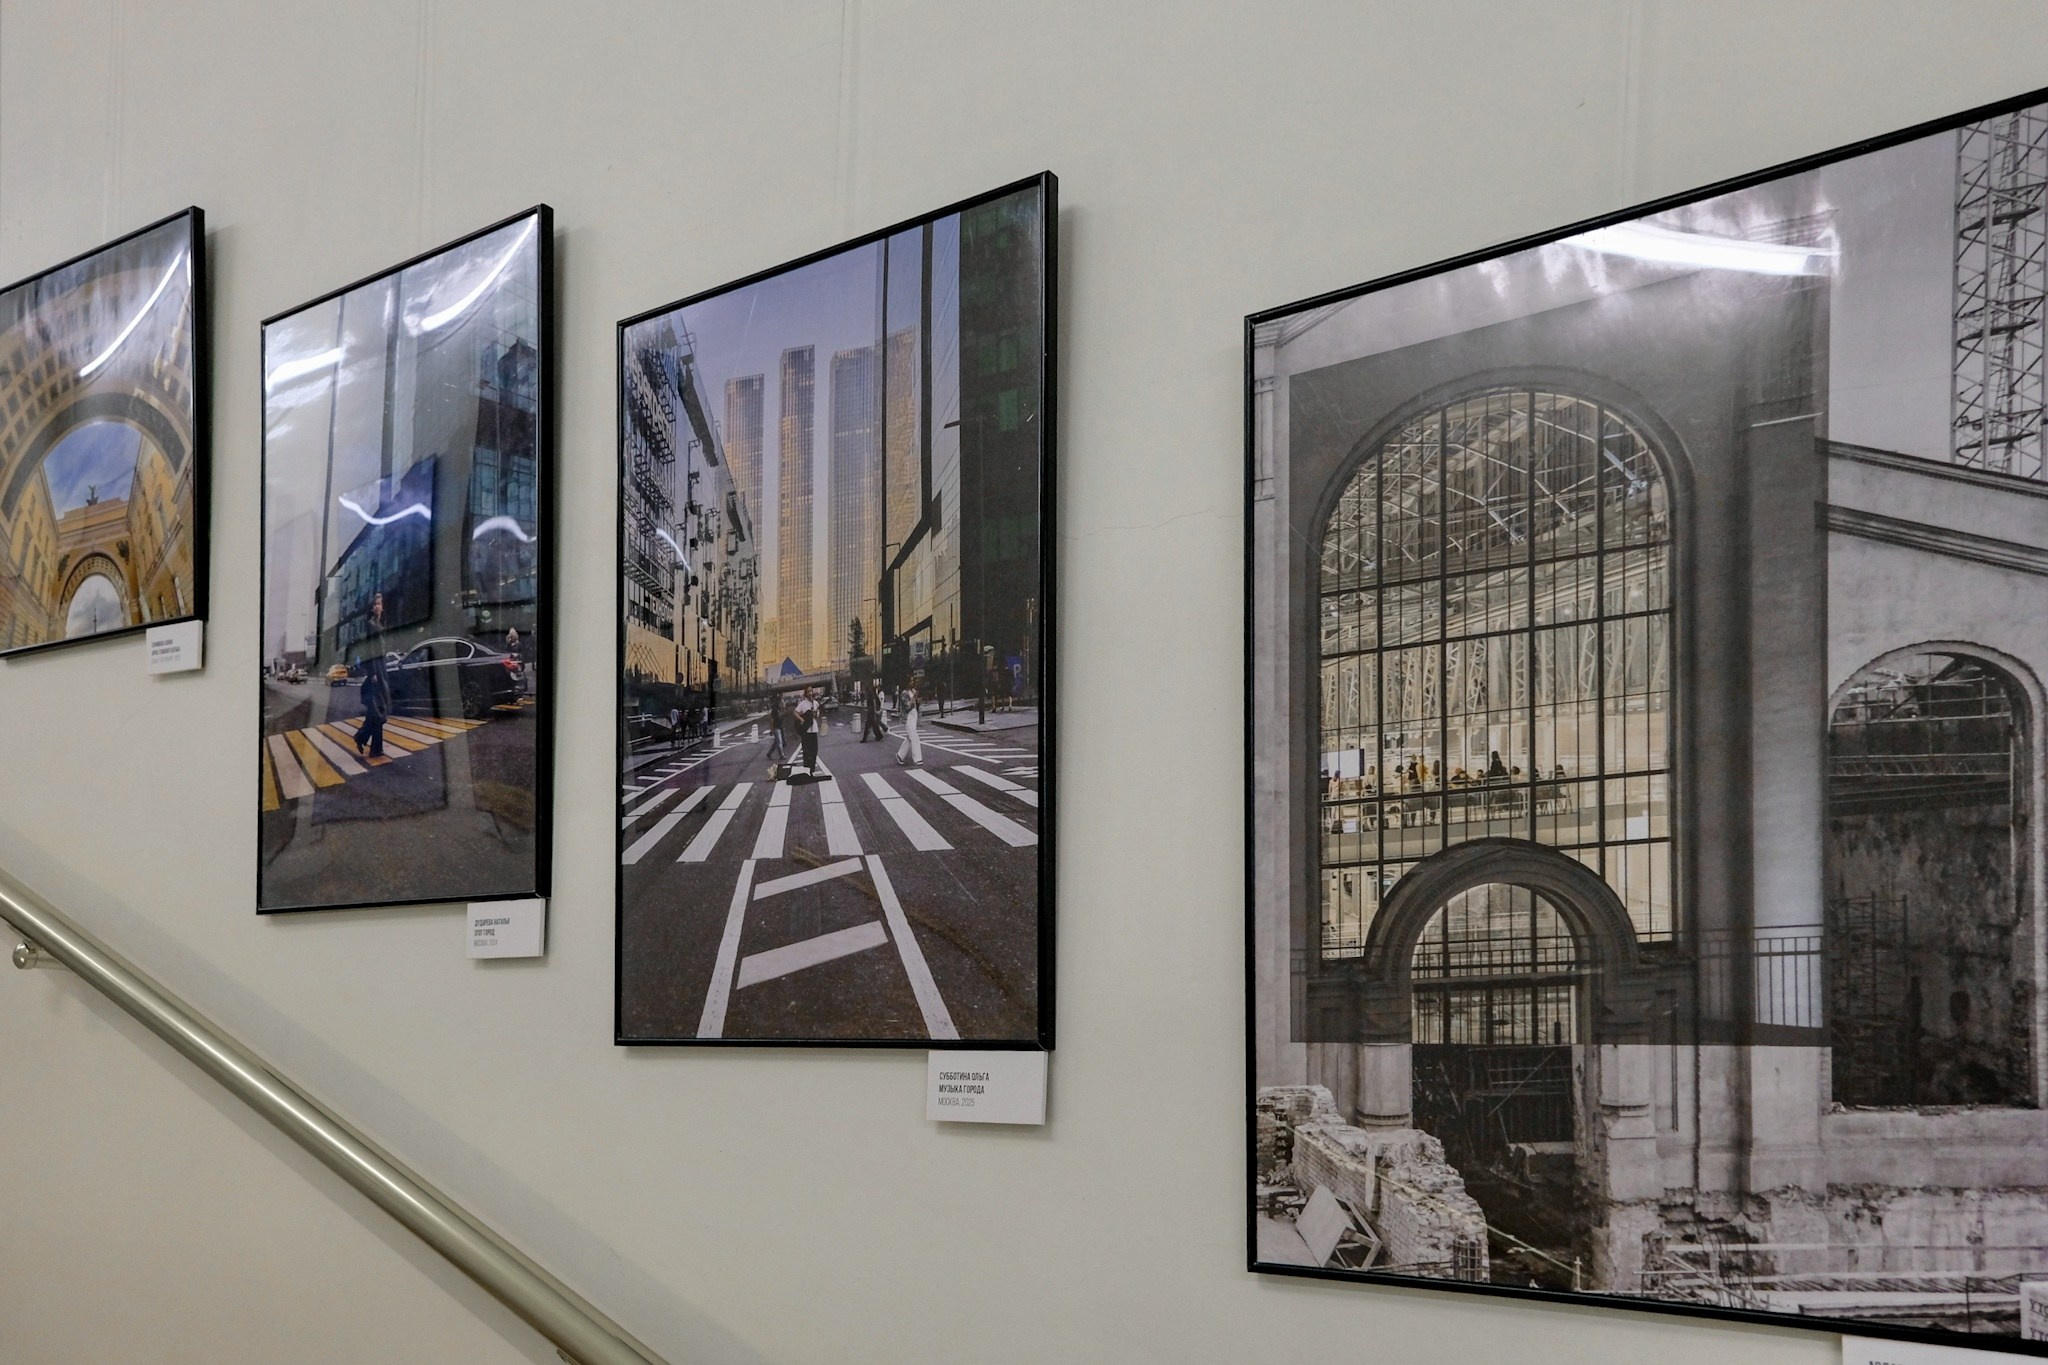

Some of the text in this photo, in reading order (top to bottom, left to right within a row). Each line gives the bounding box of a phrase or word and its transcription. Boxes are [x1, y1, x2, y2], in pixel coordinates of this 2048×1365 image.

[1013, 664, 1022, 678] P
[939, 1072, 989, 1081] СУББОТИНА ОЛЬГА
[939, 1084, 985, 1094] МУЗЫКА ГОРОДА
